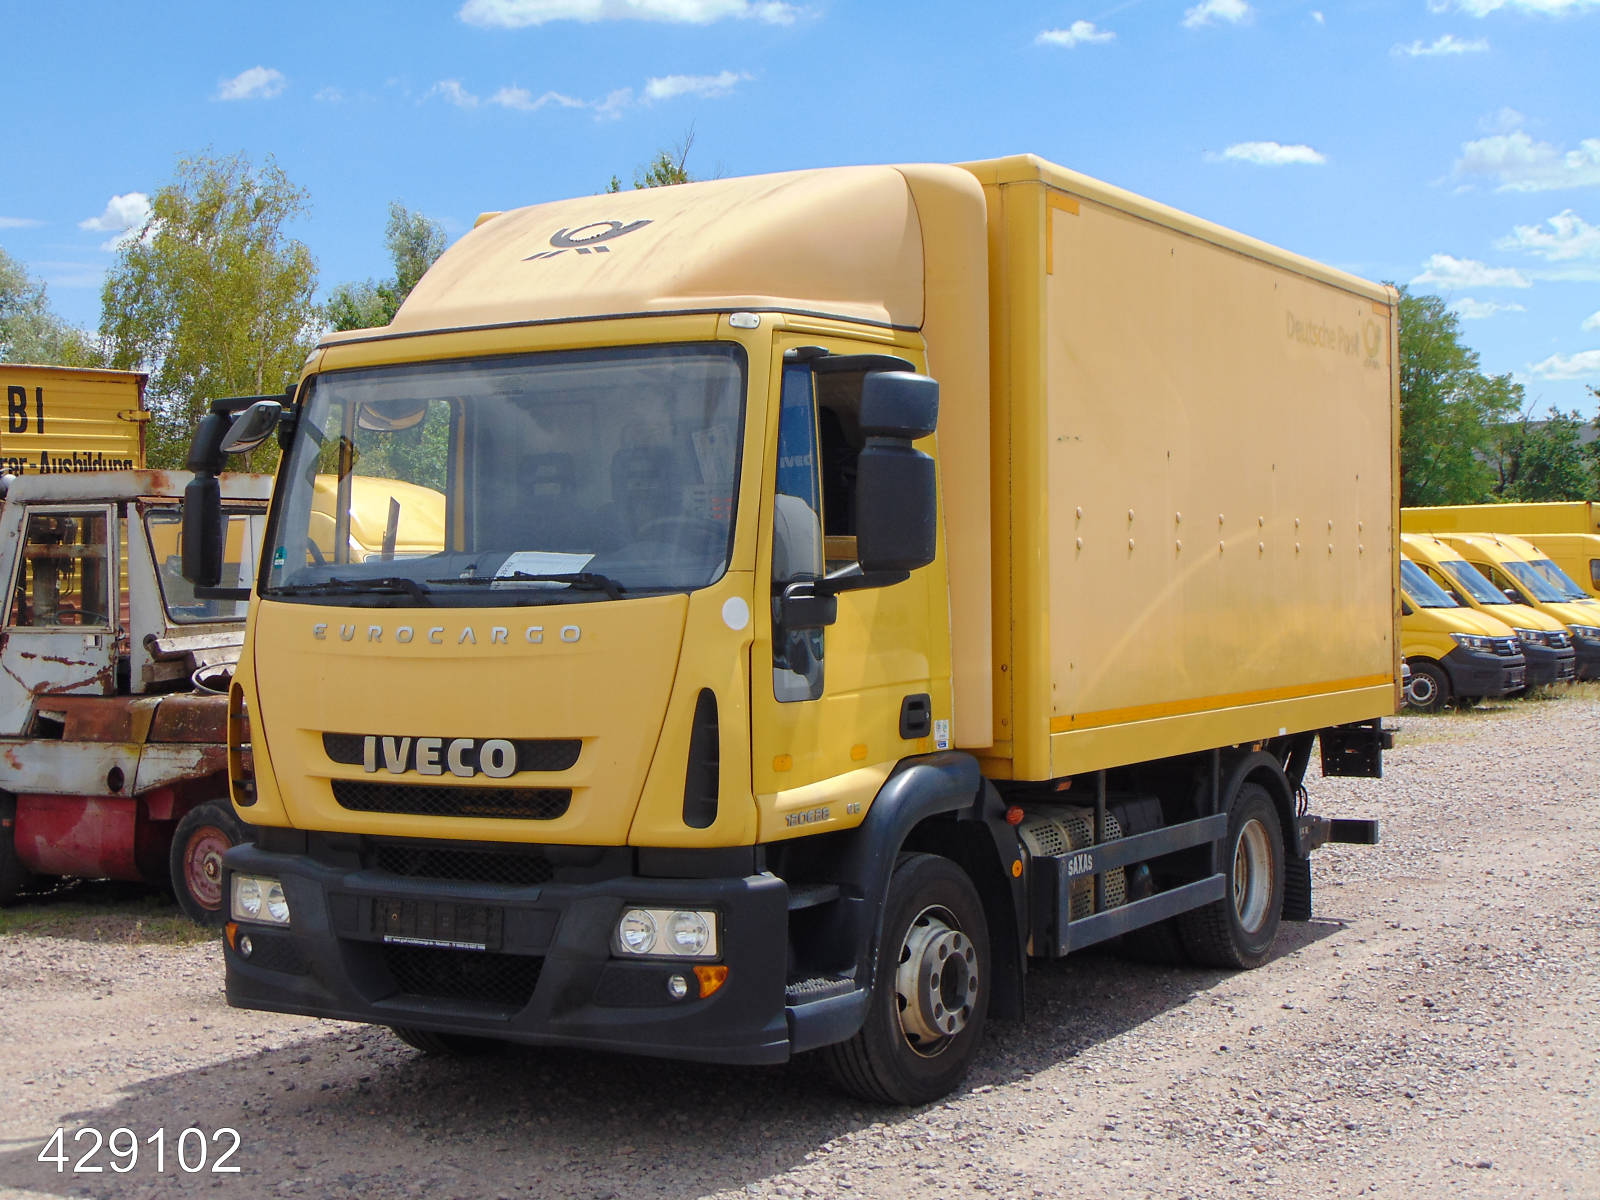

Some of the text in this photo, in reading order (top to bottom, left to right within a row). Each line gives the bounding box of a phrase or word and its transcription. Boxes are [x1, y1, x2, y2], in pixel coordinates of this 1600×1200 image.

[780, 455, 812, 468] IVEC
[313, 623, 582, 644] EUROCARGO
[363, 736, 517, 778] IVECO
[1068, 853, 1093, 876] SAXAS
